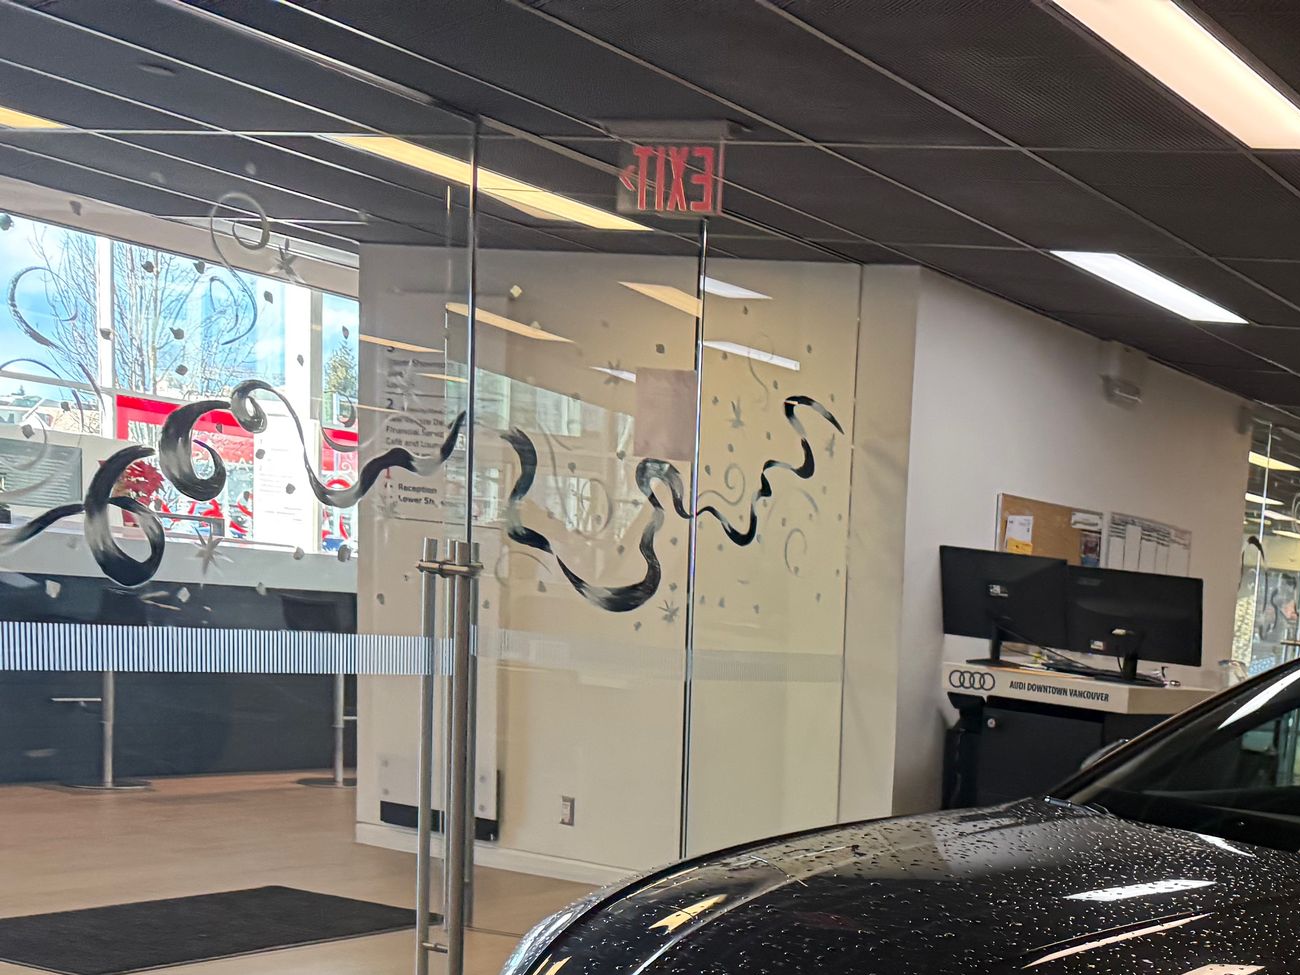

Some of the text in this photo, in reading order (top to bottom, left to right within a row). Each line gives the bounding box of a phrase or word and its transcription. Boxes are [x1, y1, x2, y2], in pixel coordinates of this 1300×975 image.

[398, 483, 438, 494] Reception
[1009, 680, 1109, 702] AUDI DOWNTOWN VANCOUVER
